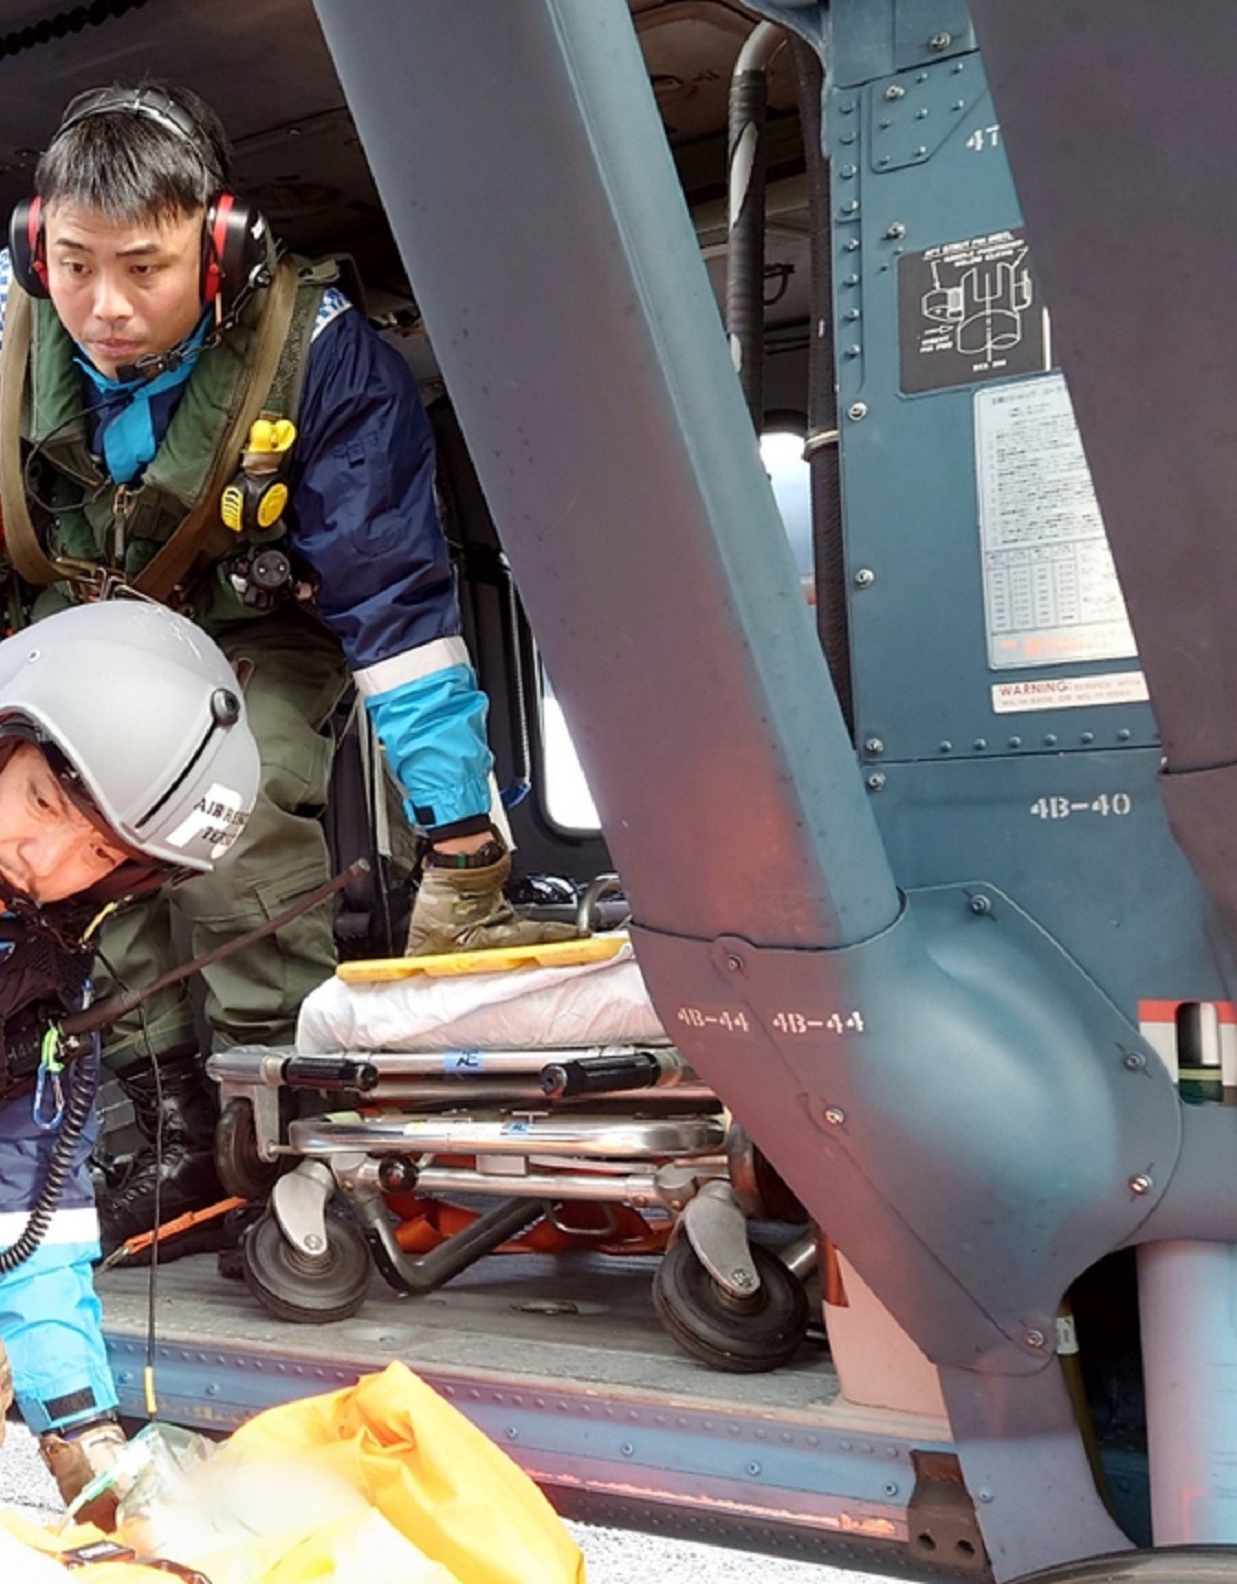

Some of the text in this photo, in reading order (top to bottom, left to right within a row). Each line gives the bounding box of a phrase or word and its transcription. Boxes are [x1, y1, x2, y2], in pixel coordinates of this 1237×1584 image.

[1029, 792, 1132, 819] 4B-40
[677, 1007, 750, 1032] 4B-44
[772, 1011, 864, 1034] 4B-44
